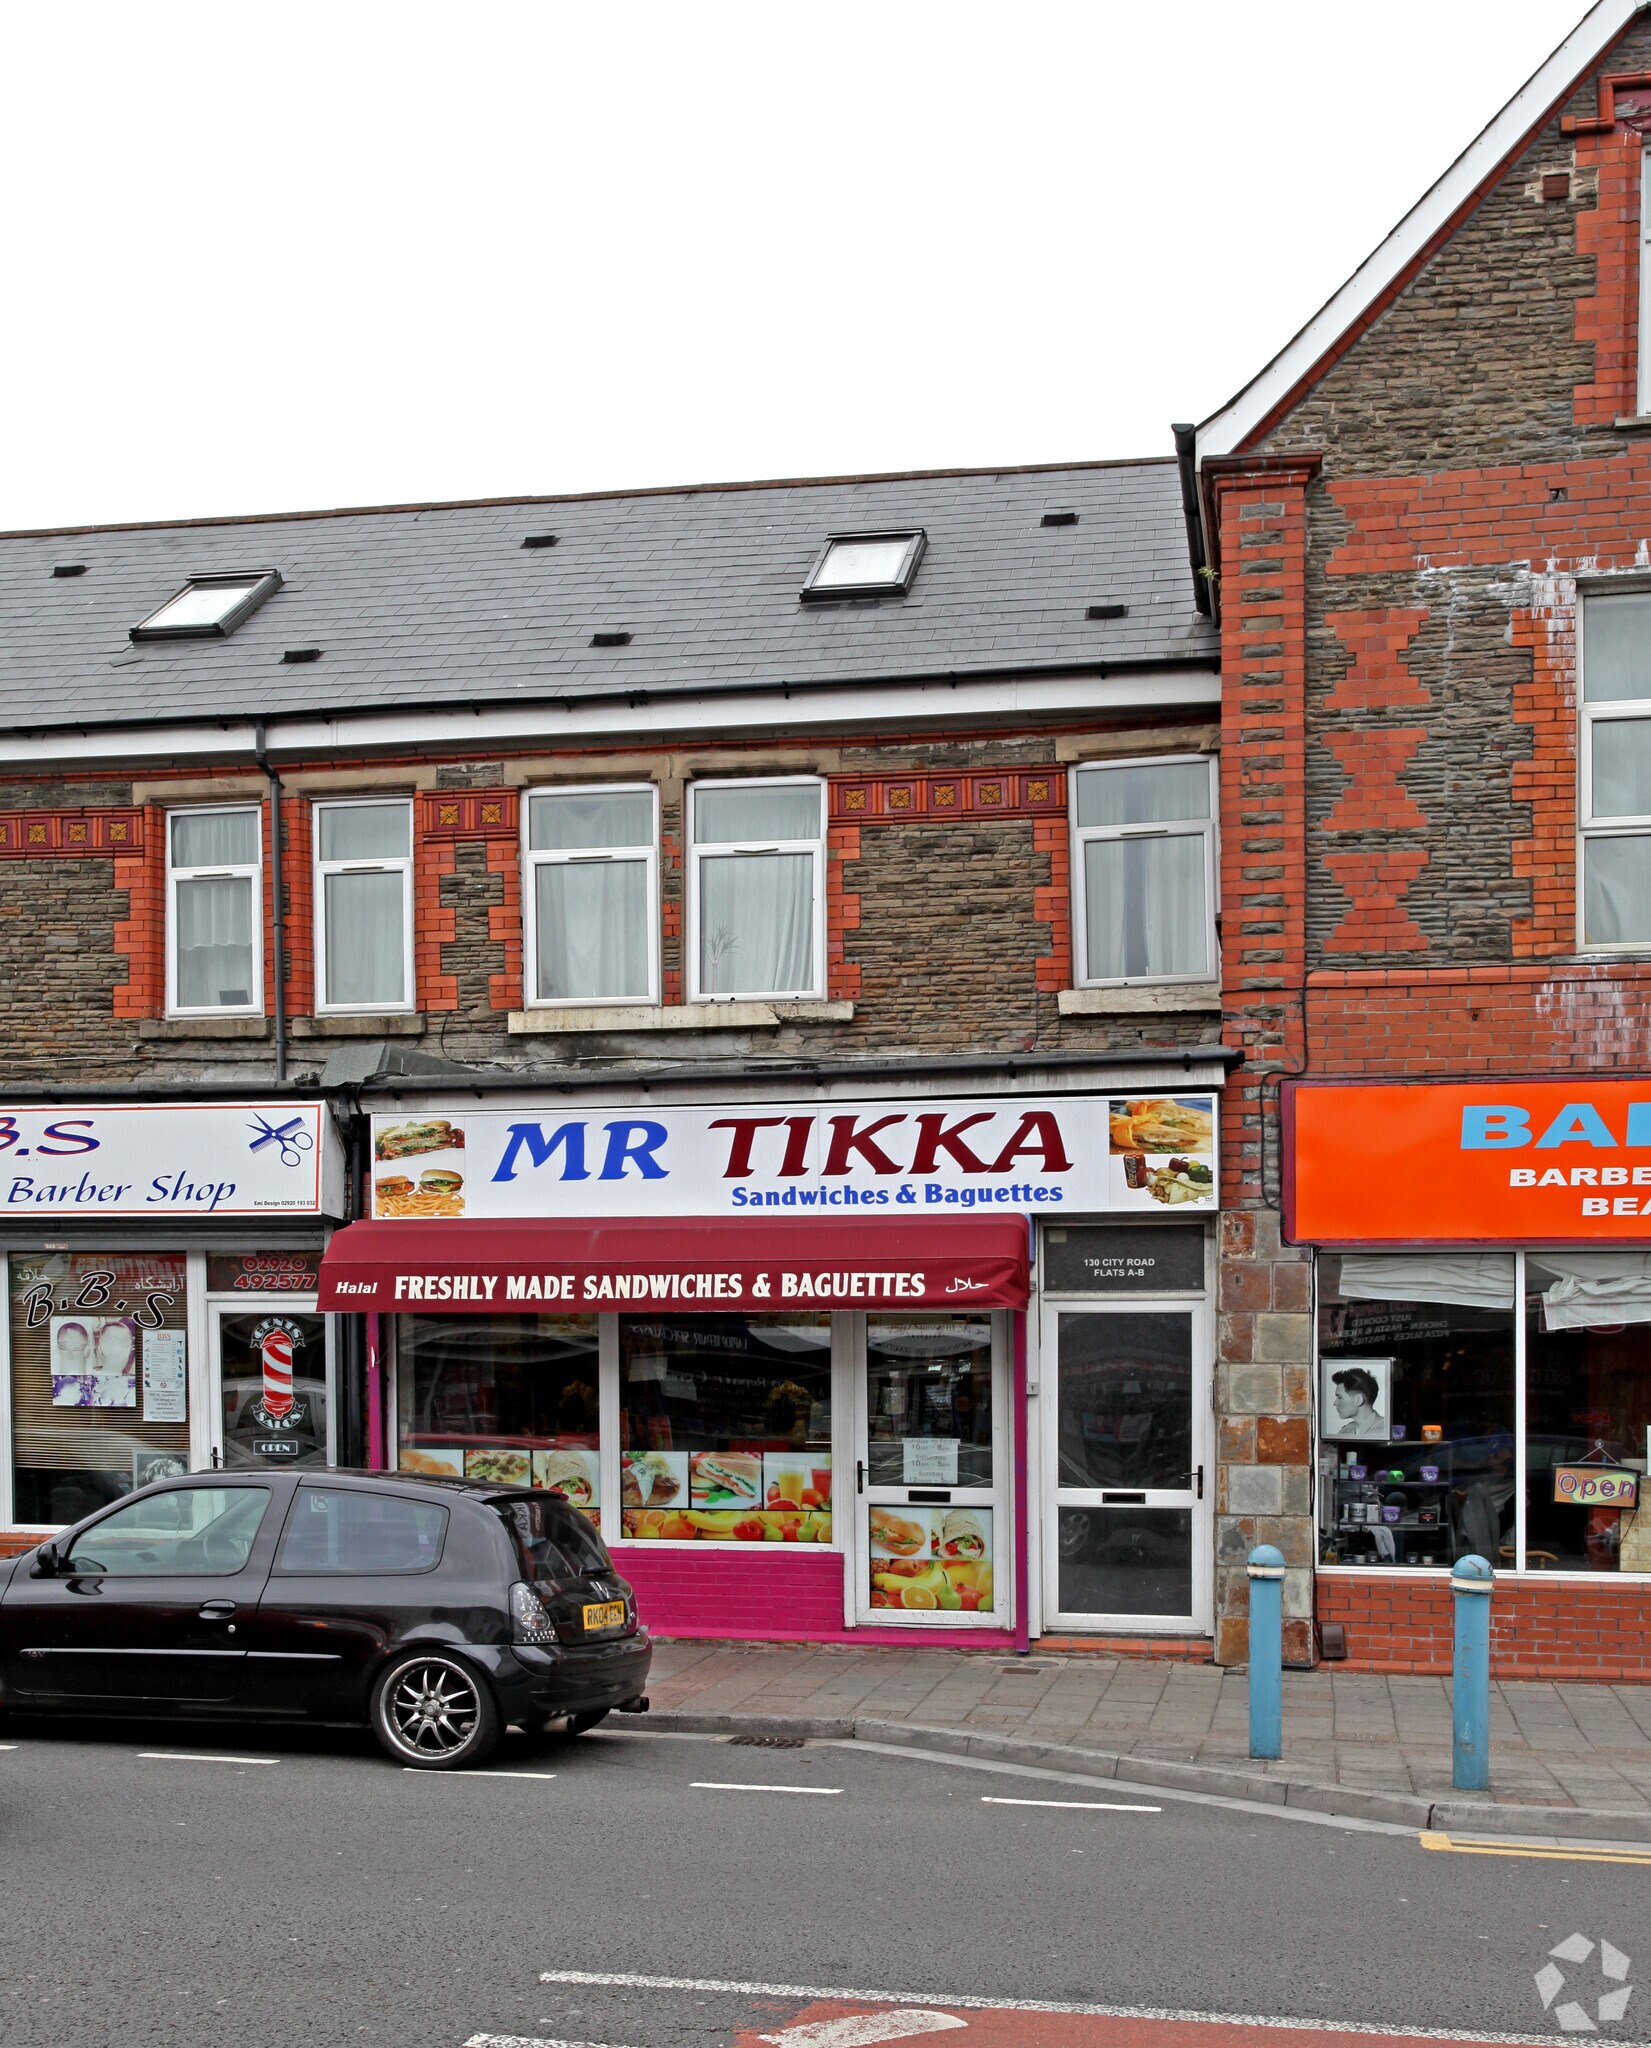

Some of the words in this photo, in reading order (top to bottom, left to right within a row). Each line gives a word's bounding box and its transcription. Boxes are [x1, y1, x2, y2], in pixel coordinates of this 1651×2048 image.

[490, 1120, 671, 1182] MR
[707, 1111, 1075, 1178] TIKKA
[7, 1171, 133, 1203] Barber
[146, 1170, 237, 1213] Shop
[732, 1185, 889, 1207] Sandwiches
[891, 1184, 917, 1204] &
[924, 1183, 1063, 1208] Baguettes
[242, 1256, 307, 1271] 02920
[1102, 1258, 1125, 1266] CITY
[1126, 1258, 1156, 1266] ROAD
[234, 1273, 317, 1289] 492577
[1094, 1268, 1125, 1277] FLATS
[1127, 1268, 1145, 1277] A-B
[335, 1282, 378, 1294] Halal
[394, 1276, 498, 1300] FRESHLY
[506, 1275, 575, 1299] MADE
[583, 1273, 743, 1299] SANDWICHES
[752, 1273, 771, 1298] &
[781, 1272, 925, 1297] BAGUETTES
[945, 1277, 989, 1293] حلال
[253, 1318, 301, 1339] GENTS
[257, 1412, 301, 1429] SALON
[261, 1443, 290, 1452] OPEN
[1557, 1472, 1635, 1500] Open
